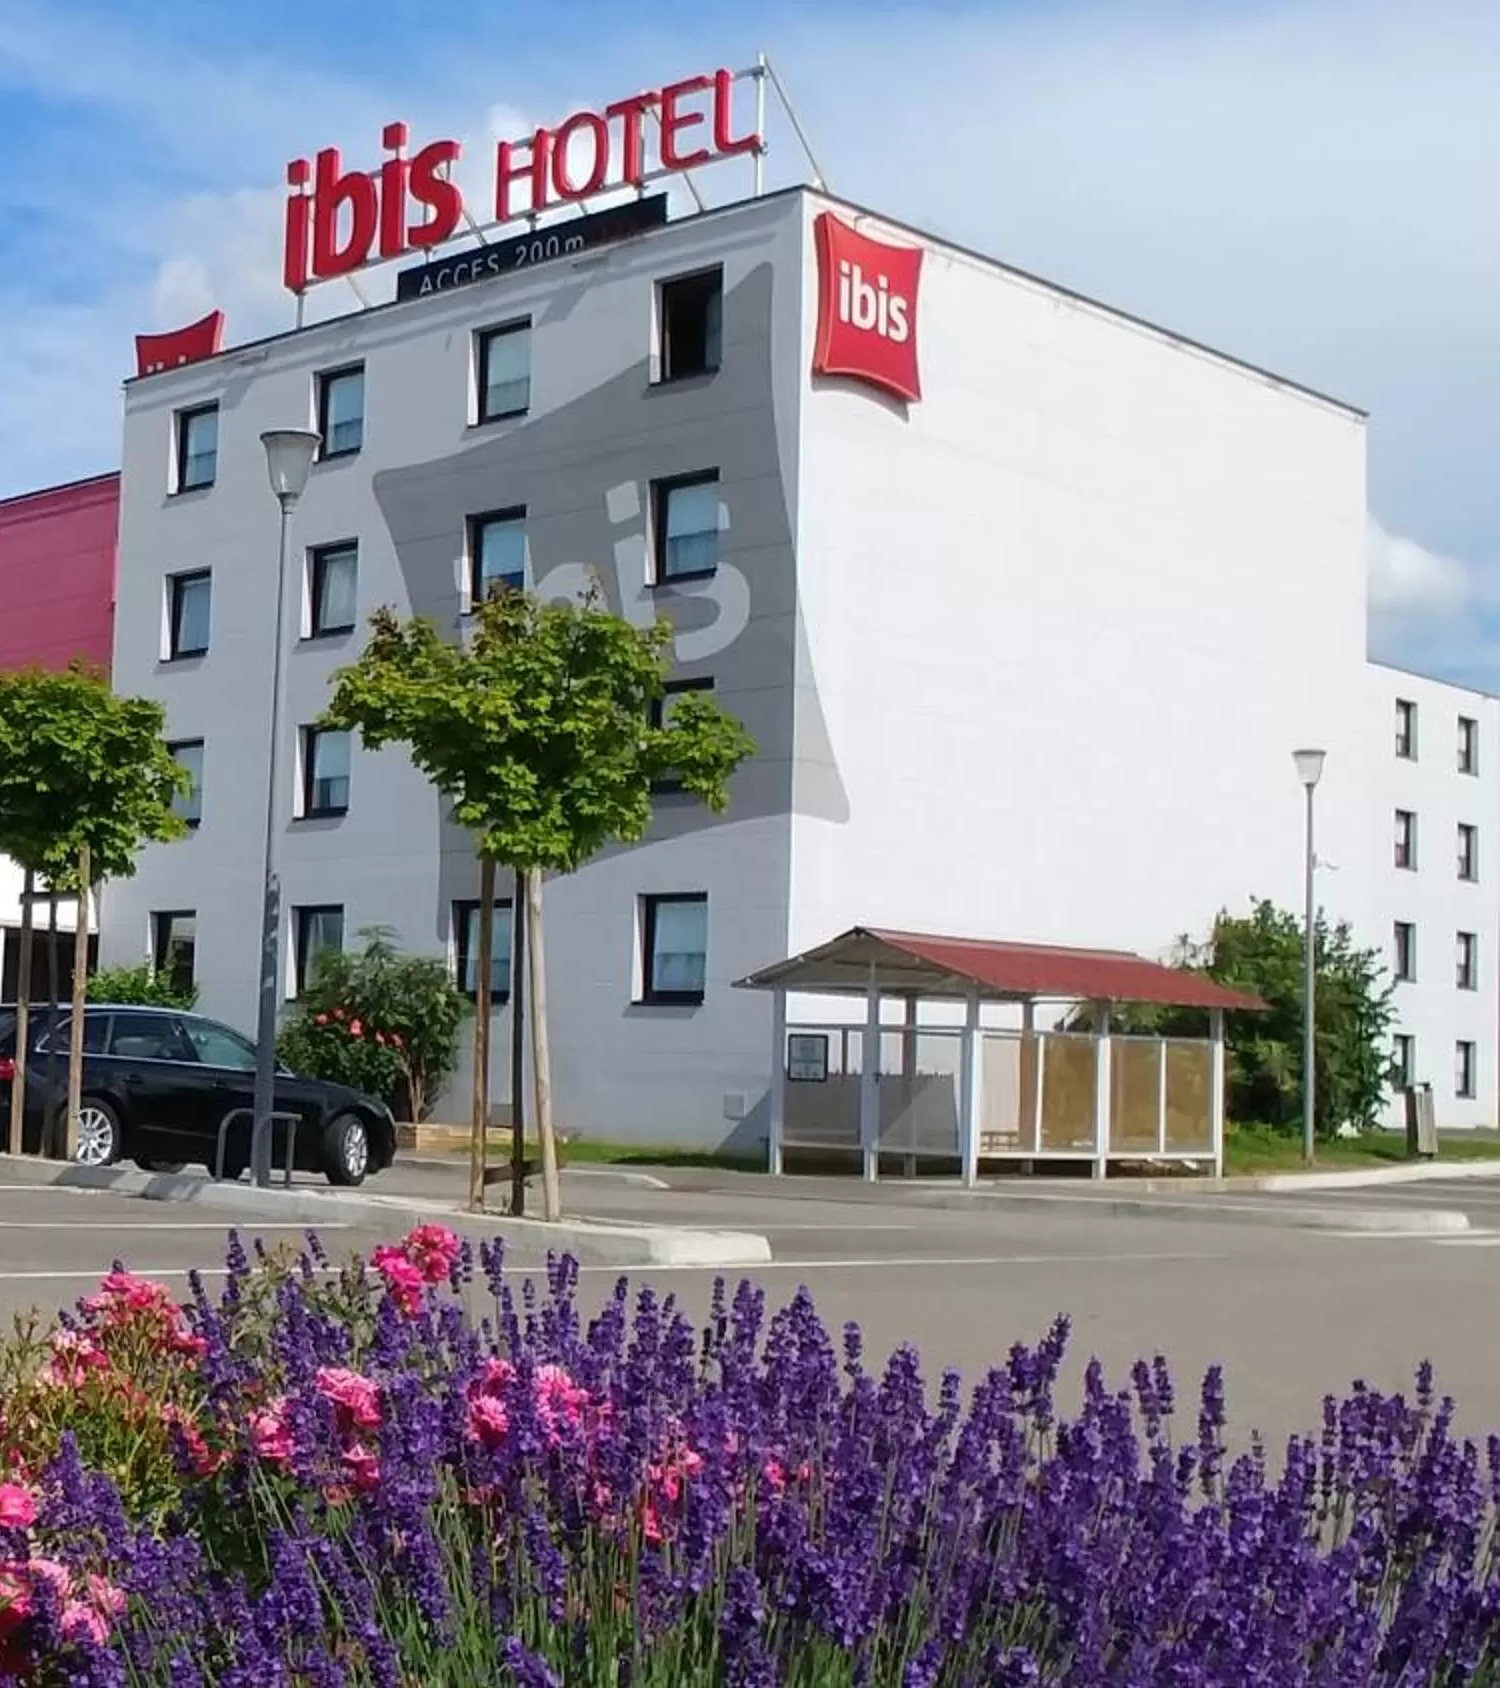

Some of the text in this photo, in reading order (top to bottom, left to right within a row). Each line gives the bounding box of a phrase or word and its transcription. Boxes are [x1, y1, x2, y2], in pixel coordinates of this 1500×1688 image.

[284, 67, 760, 293] ibis HOTEL
[838, 258, 909, 344] ibis
